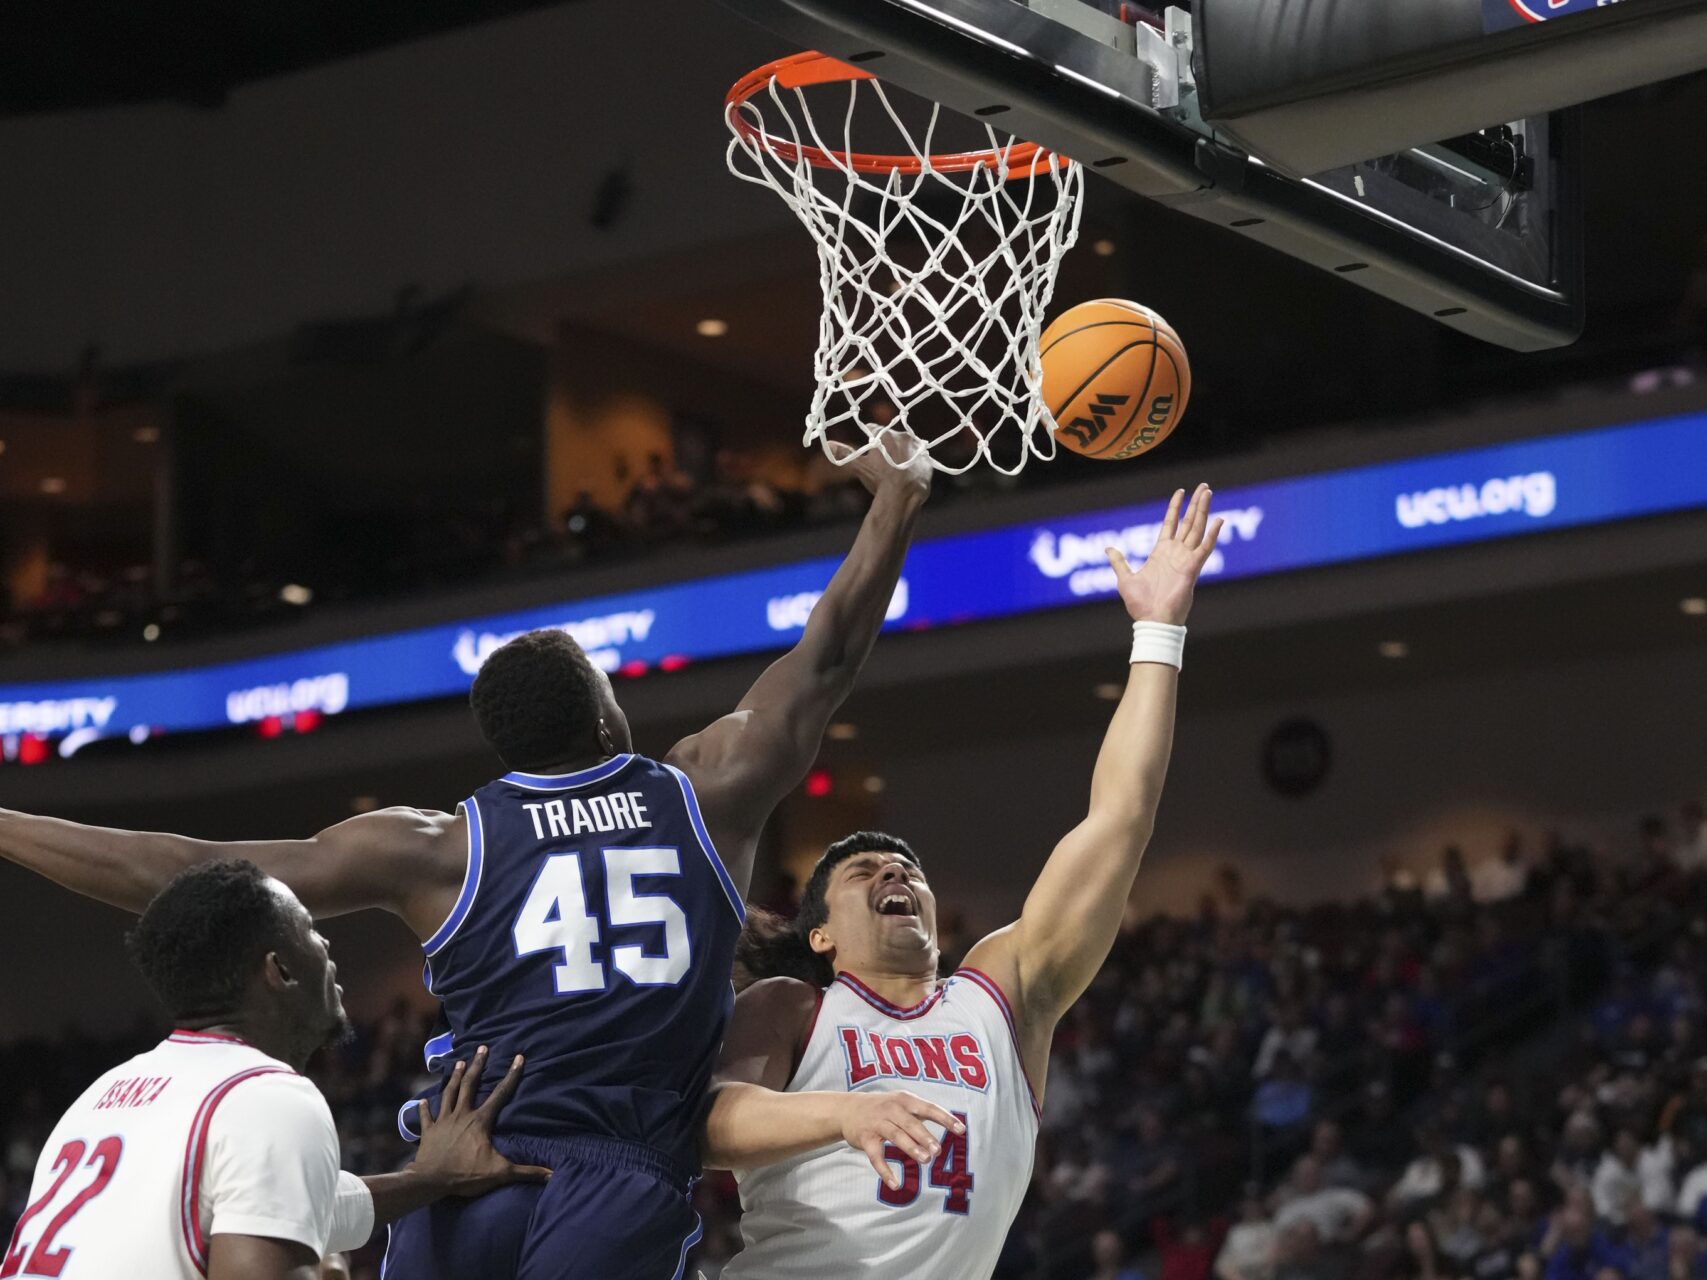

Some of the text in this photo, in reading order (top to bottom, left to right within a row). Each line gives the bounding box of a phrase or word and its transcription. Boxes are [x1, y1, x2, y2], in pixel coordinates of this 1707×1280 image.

[1397, 471, 1556, 528] ucu.org
[522, 791, 653, 841] TRAORE
[511, 845, 692, 996] 45
[837, 1024, 991, 1094] LIONS
